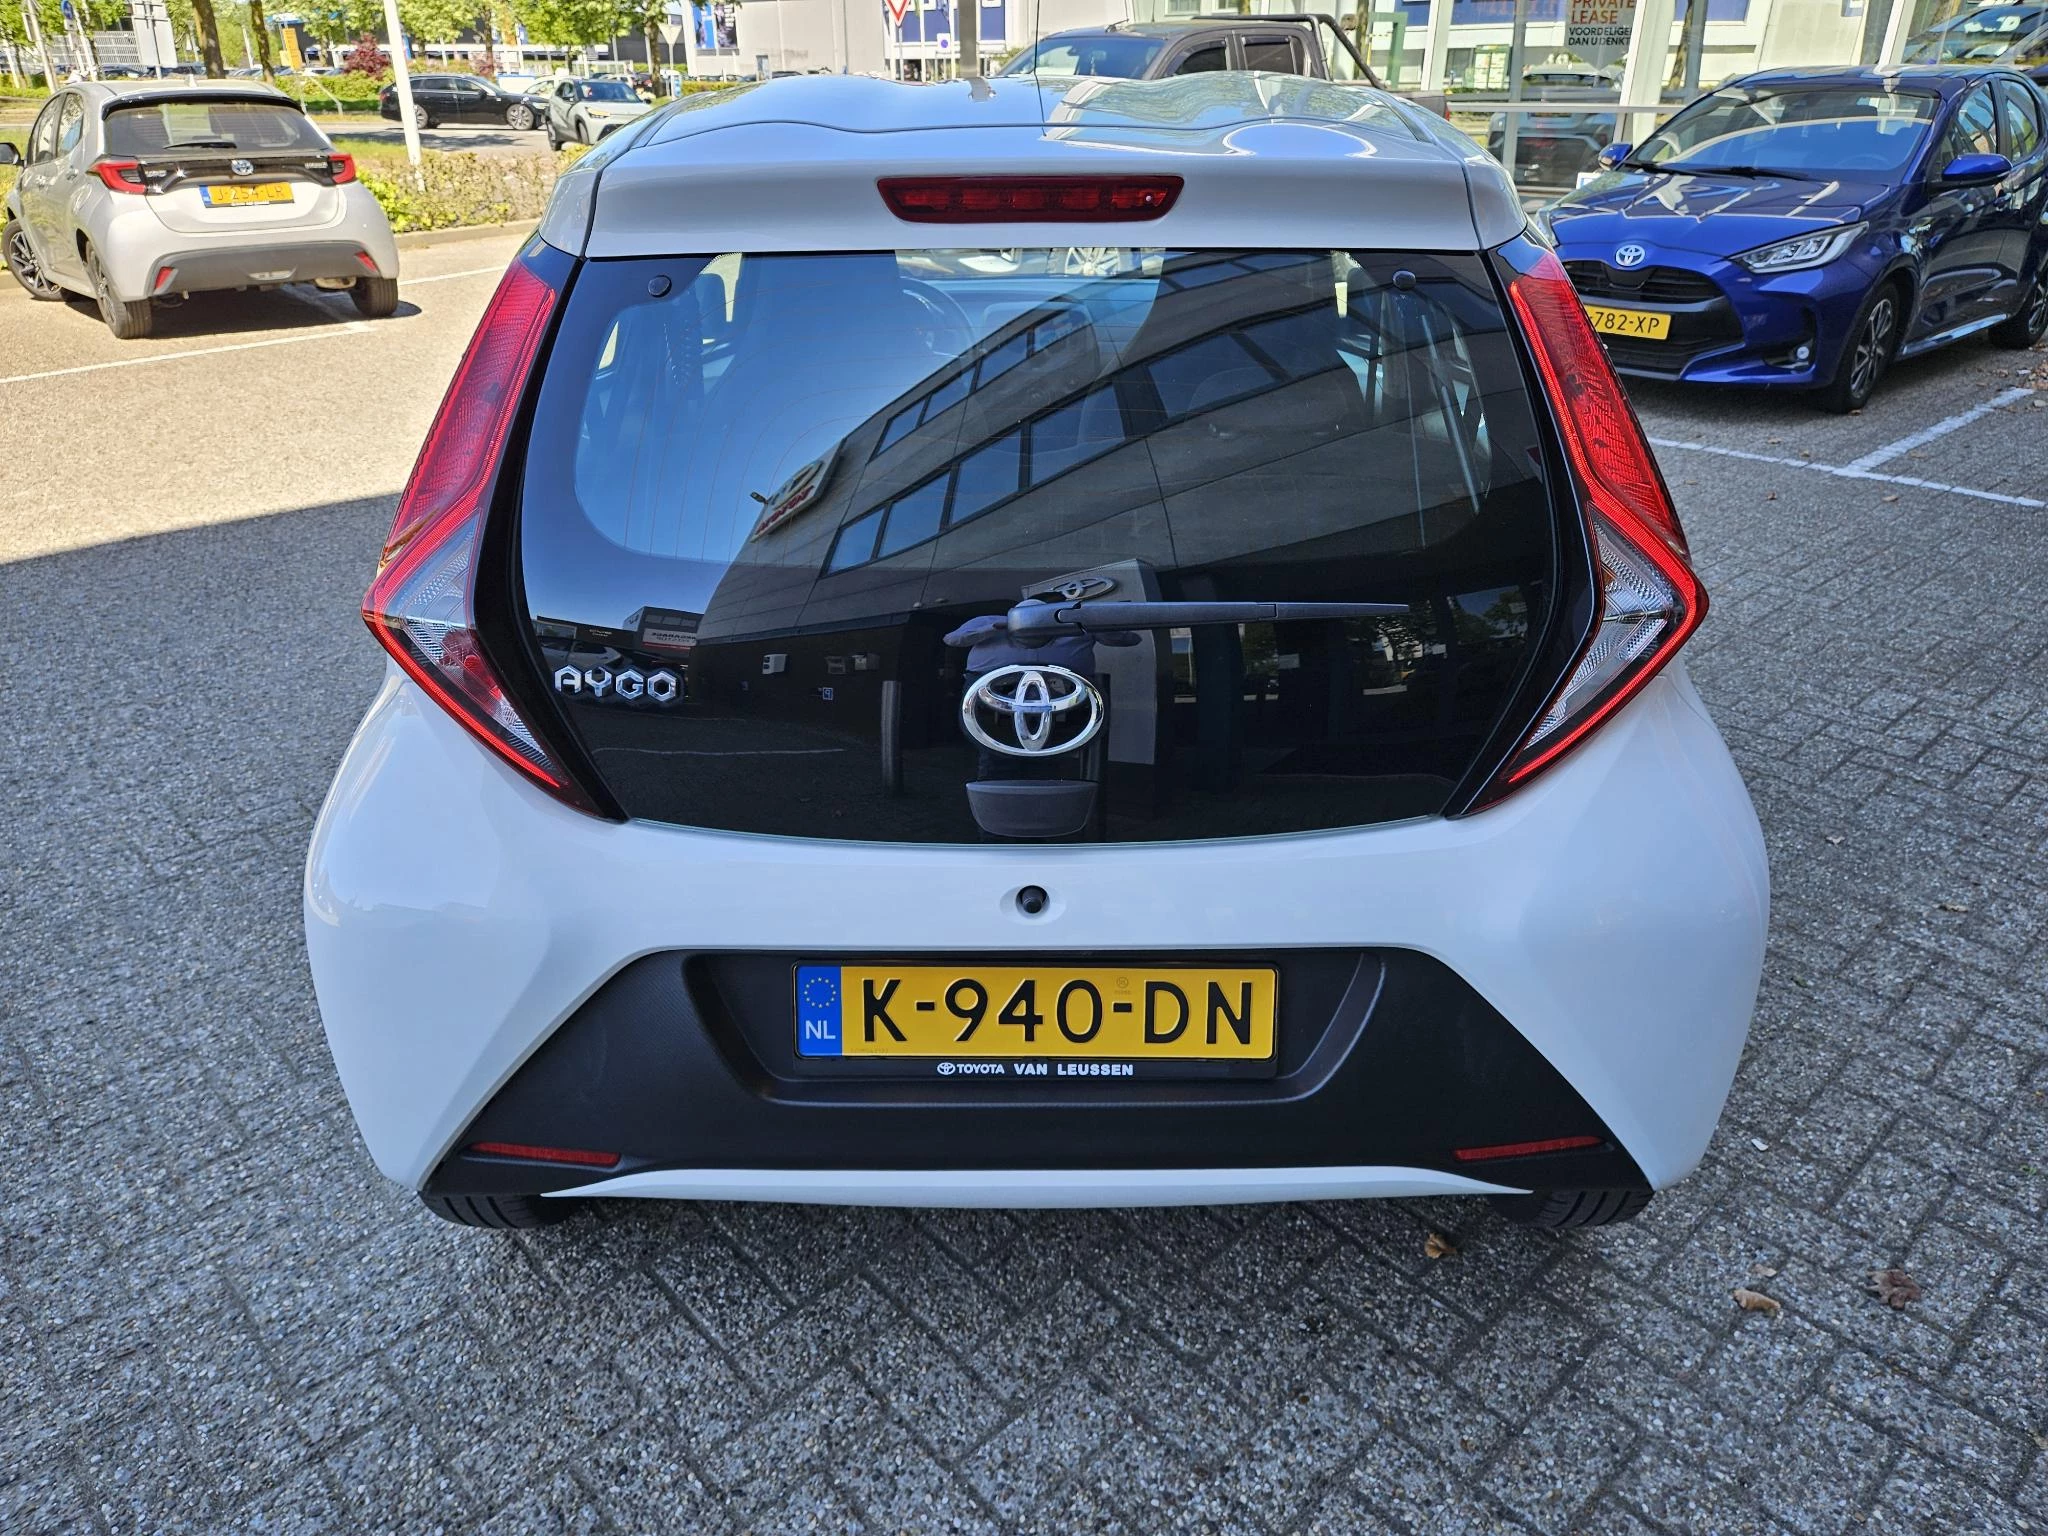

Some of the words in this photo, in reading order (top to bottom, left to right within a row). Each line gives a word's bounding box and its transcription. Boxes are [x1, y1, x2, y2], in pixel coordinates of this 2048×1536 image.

[1573, 0, 1635, 8] PRIVATE
[1571, 10, 1618, 24] LEASE
[1569, 27, 1632, 36] VOORDELIGE
[1568, 37, 1588, 46] DAN
[1591, 37, 1598, 46] U
[1599, 37, 1630, 46] DENKT
[1588, 311, 1660, 333] -782-XP
[554, 664, 677, 701] AYGO
[806, 1021, 836, 1040] NL
[861, 978, 1252, 1045] K-940-DN
[956, 1063, 1005, 1075] TOYOTA
[1013, 1063, 1048, 1075] VAN
[1057, 1063, 1134, 1076] LEUSSEN
